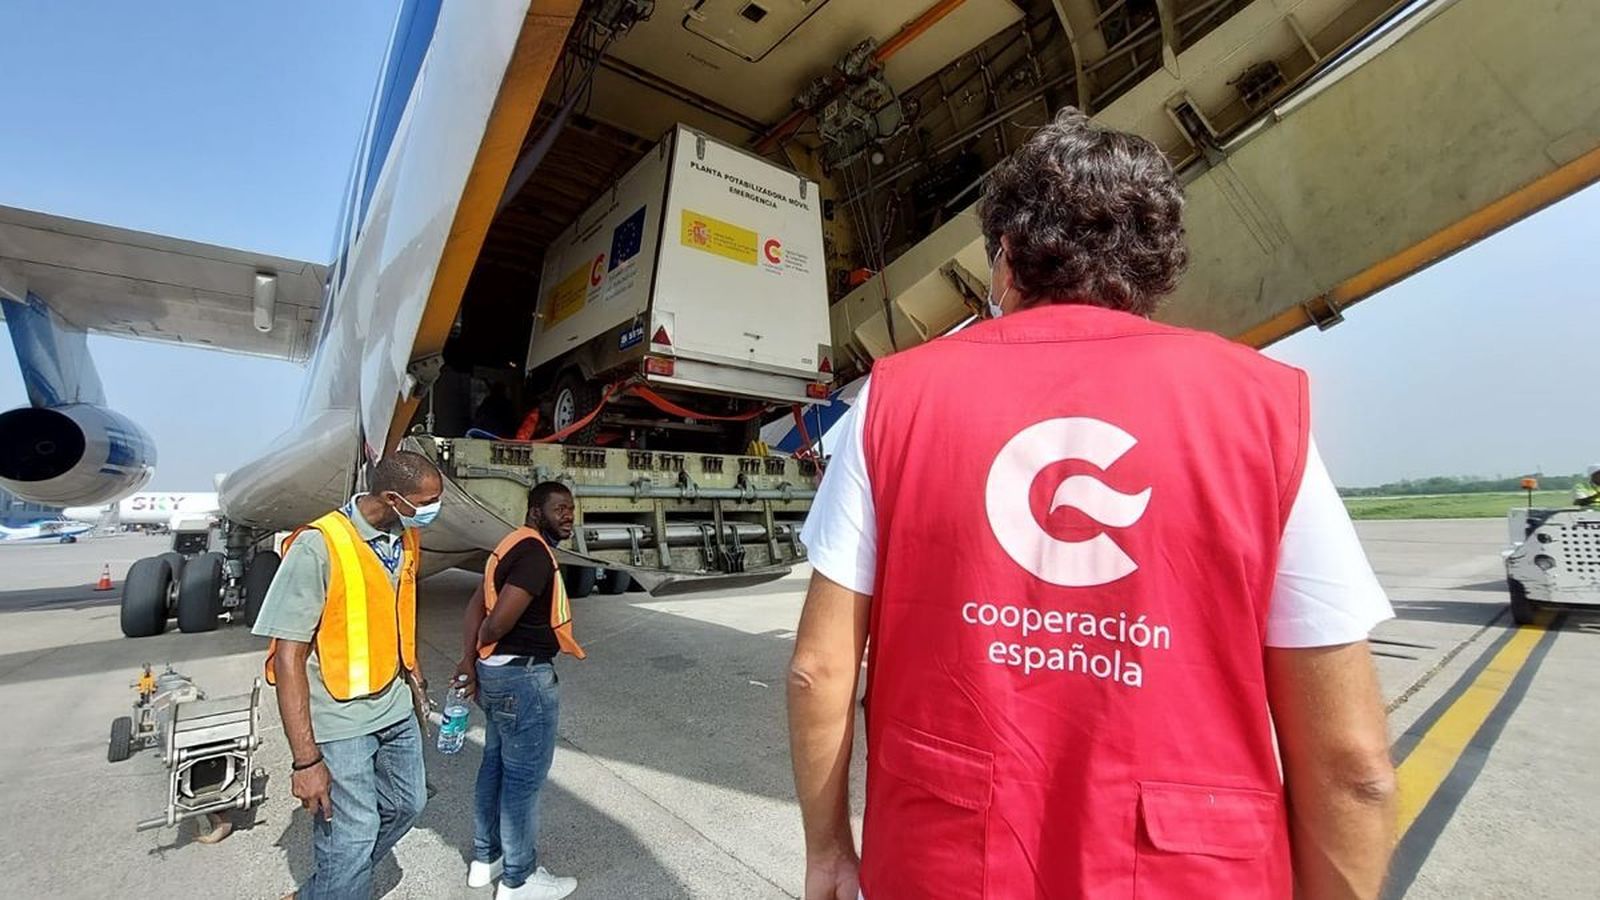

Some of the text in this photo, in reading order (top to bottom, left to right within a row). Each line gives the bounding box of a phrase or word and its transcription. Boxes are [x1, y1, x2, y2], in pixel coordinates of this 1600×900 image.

[690, 161, 722, 178] PLANTA
[724, 174, 787, 201] POTABILIZADORA
[729, 186, 778, 209] EMERGENCIA
[132, 496, 186, 511] SKY
[962, 602, 1170, 650] cooperación
[988, 641, 1143, 688] española
